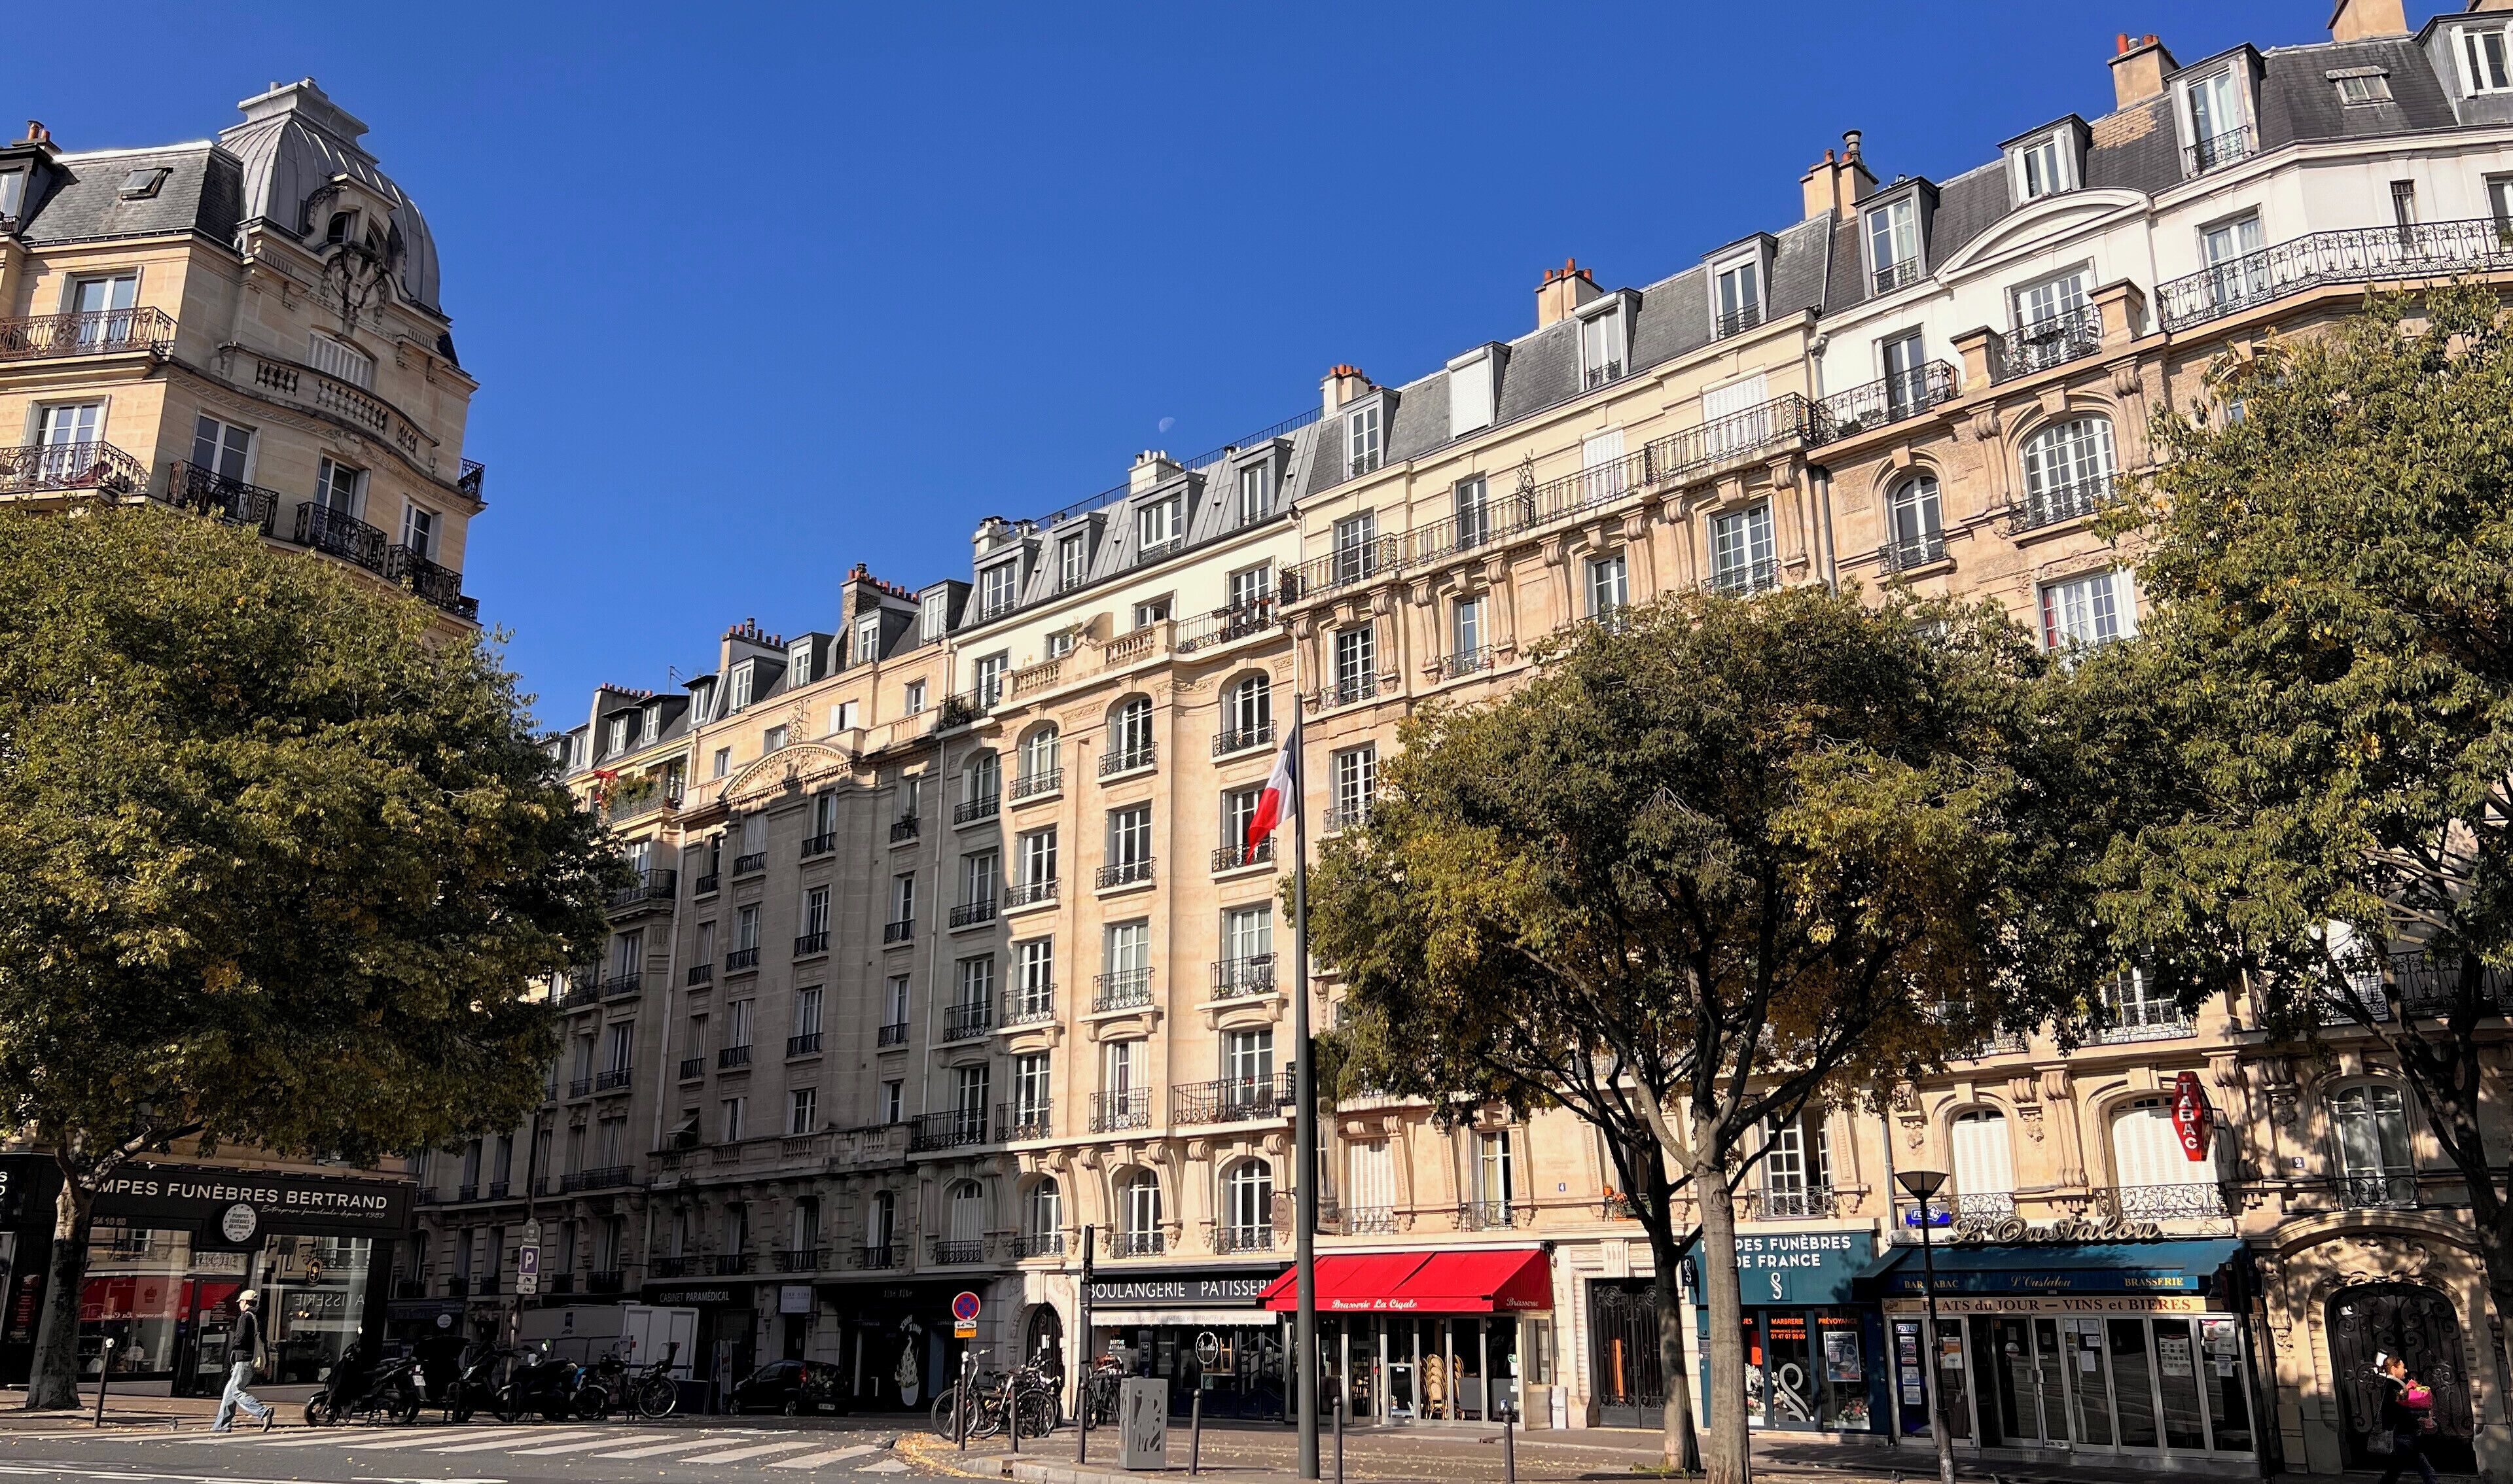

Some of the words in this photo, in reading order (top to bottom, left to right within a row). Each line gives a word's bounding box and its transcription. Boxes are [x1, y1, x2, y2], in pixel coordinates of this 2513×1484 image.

[2179, 1082, 2198, 1150] TABAC
[2294, 1157, 2302, 1167] 2
[98, 1179, 158, 1196] MPES
[167, 1182, 279, 1203] FUNÈBRES
[286, 1190, 388, 1210] BERTRAND
[1945, 1214, 2162, 1243] L'Oustalou
[1770, 1234, 1852, 1251] FUNÈBRES
[524, 1251, 535, 1269] P
[1758, 1253, 1821, 1268] FRANCE
[1904, 1280, 1924, 1289] BAR
[1933, 1280, 1959, 1288] ABAC
[2010, 1275, 2071, 1288] L'Oustalou
[2124, 1277, 2184, 1287] BRASSERIE
[1091, 1282, 1186, 1299] BOULANGERIE
[1201, 1279, 1276, 1298] PATISSER
[660, 1292, 684, 1303] CABINET
[685, 1289, 730, 1302] PARAMÉDICAL
[1506, 1298, 1539, 1307] Brasserie
[1331, 1298, 1371, 1309] Brasserie
[1373, 1298, 1387, 1309] La
[1389, 1298, 1418, 1310] Cigale
[1922, 1299, 1970, 1311] PATS
[1975, 1299, 1992, 1311] du
[1996, 1299, 2041, 1311] JOUR
[2062, 1299, 2103, 1310] VINS
[2108, 1299, 2122, 1310] et
[1818, 1316, 1858, 1325] PRÉVOYANCE
